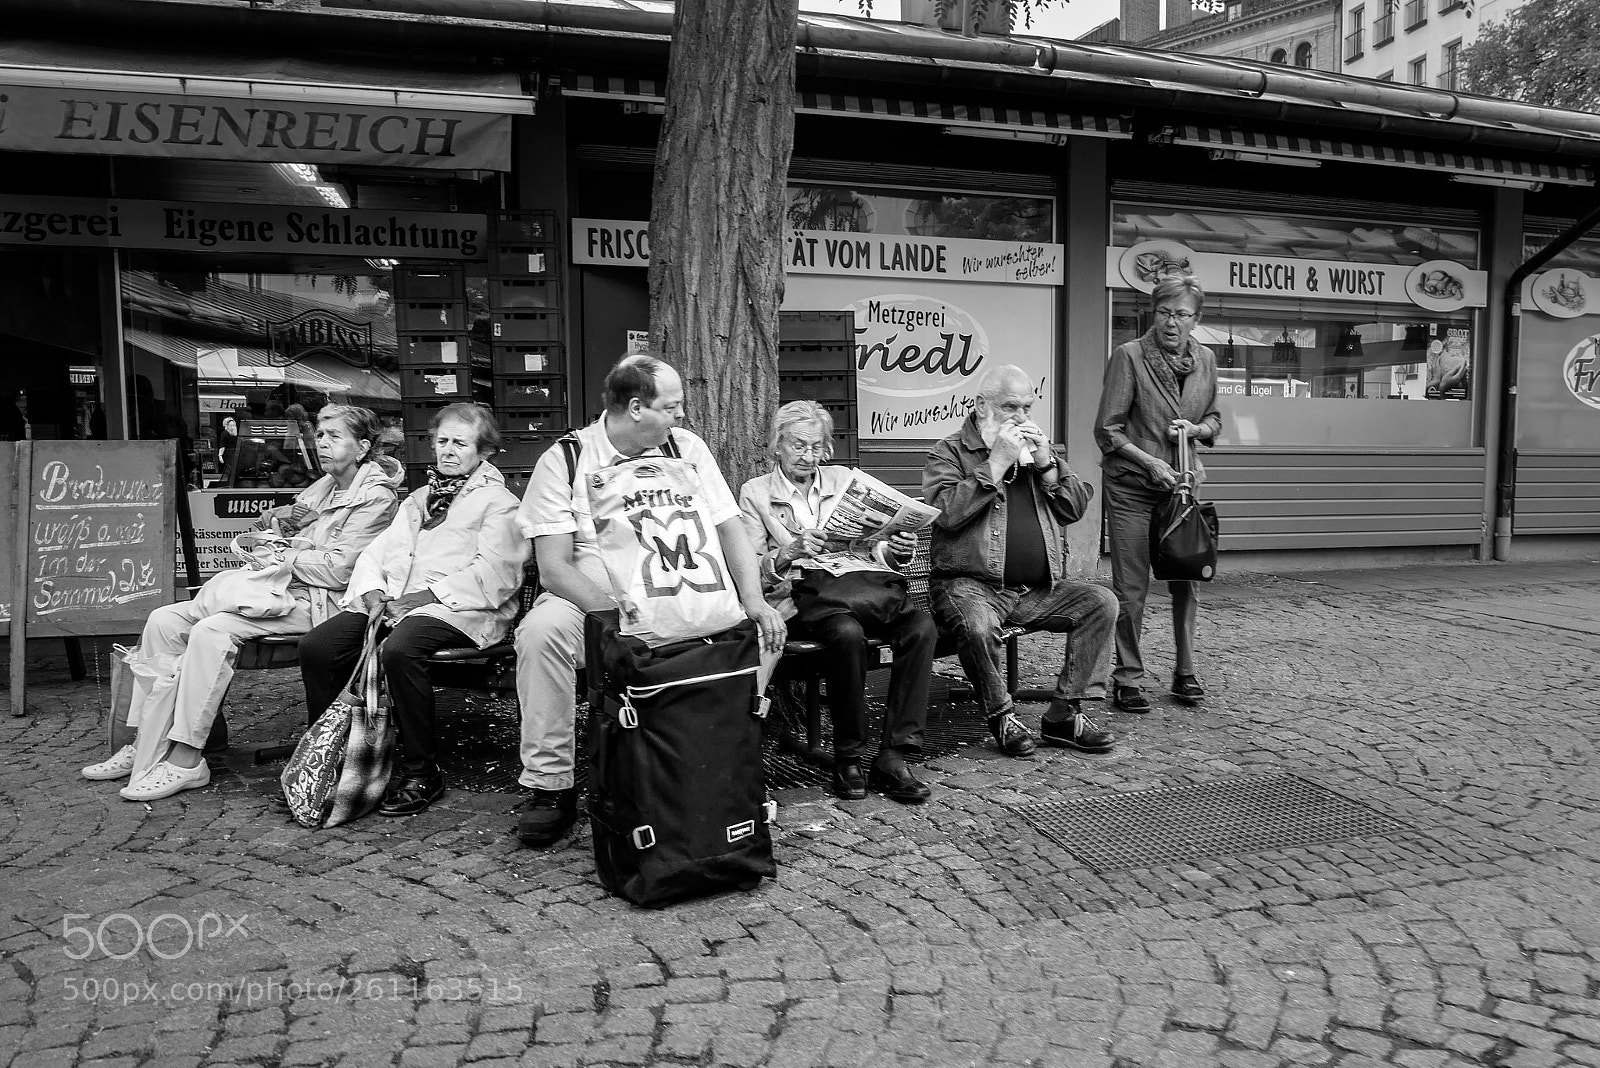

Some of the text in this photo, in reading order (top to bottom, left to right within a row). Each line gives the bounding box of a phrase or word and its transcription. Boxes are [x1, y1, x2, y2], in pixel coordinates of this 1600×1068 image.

[54, 99, 462, 157] EISENREICH
[0, 205, 478, 256] zgerei Eigene Schlachtung
[587, 227, 947, 273] FRISC ÄT VOM LANDE
[962, 244, 1045, 275] Wir wurschten
[1015, 255, 1056, 281] selber!
[1229, 261, 1386, 296] FLEISCH & WURST
[868, 300, 946, 332] Metzgerei
[1234, 384, 1272, 398] Gelügel
[1574, 357, 1600, 394] Fr
[870, 394, 975, 435] Wir wurschte
[227, 498, 276, 514] unser
[213, 557, 247, 570] Schwe
